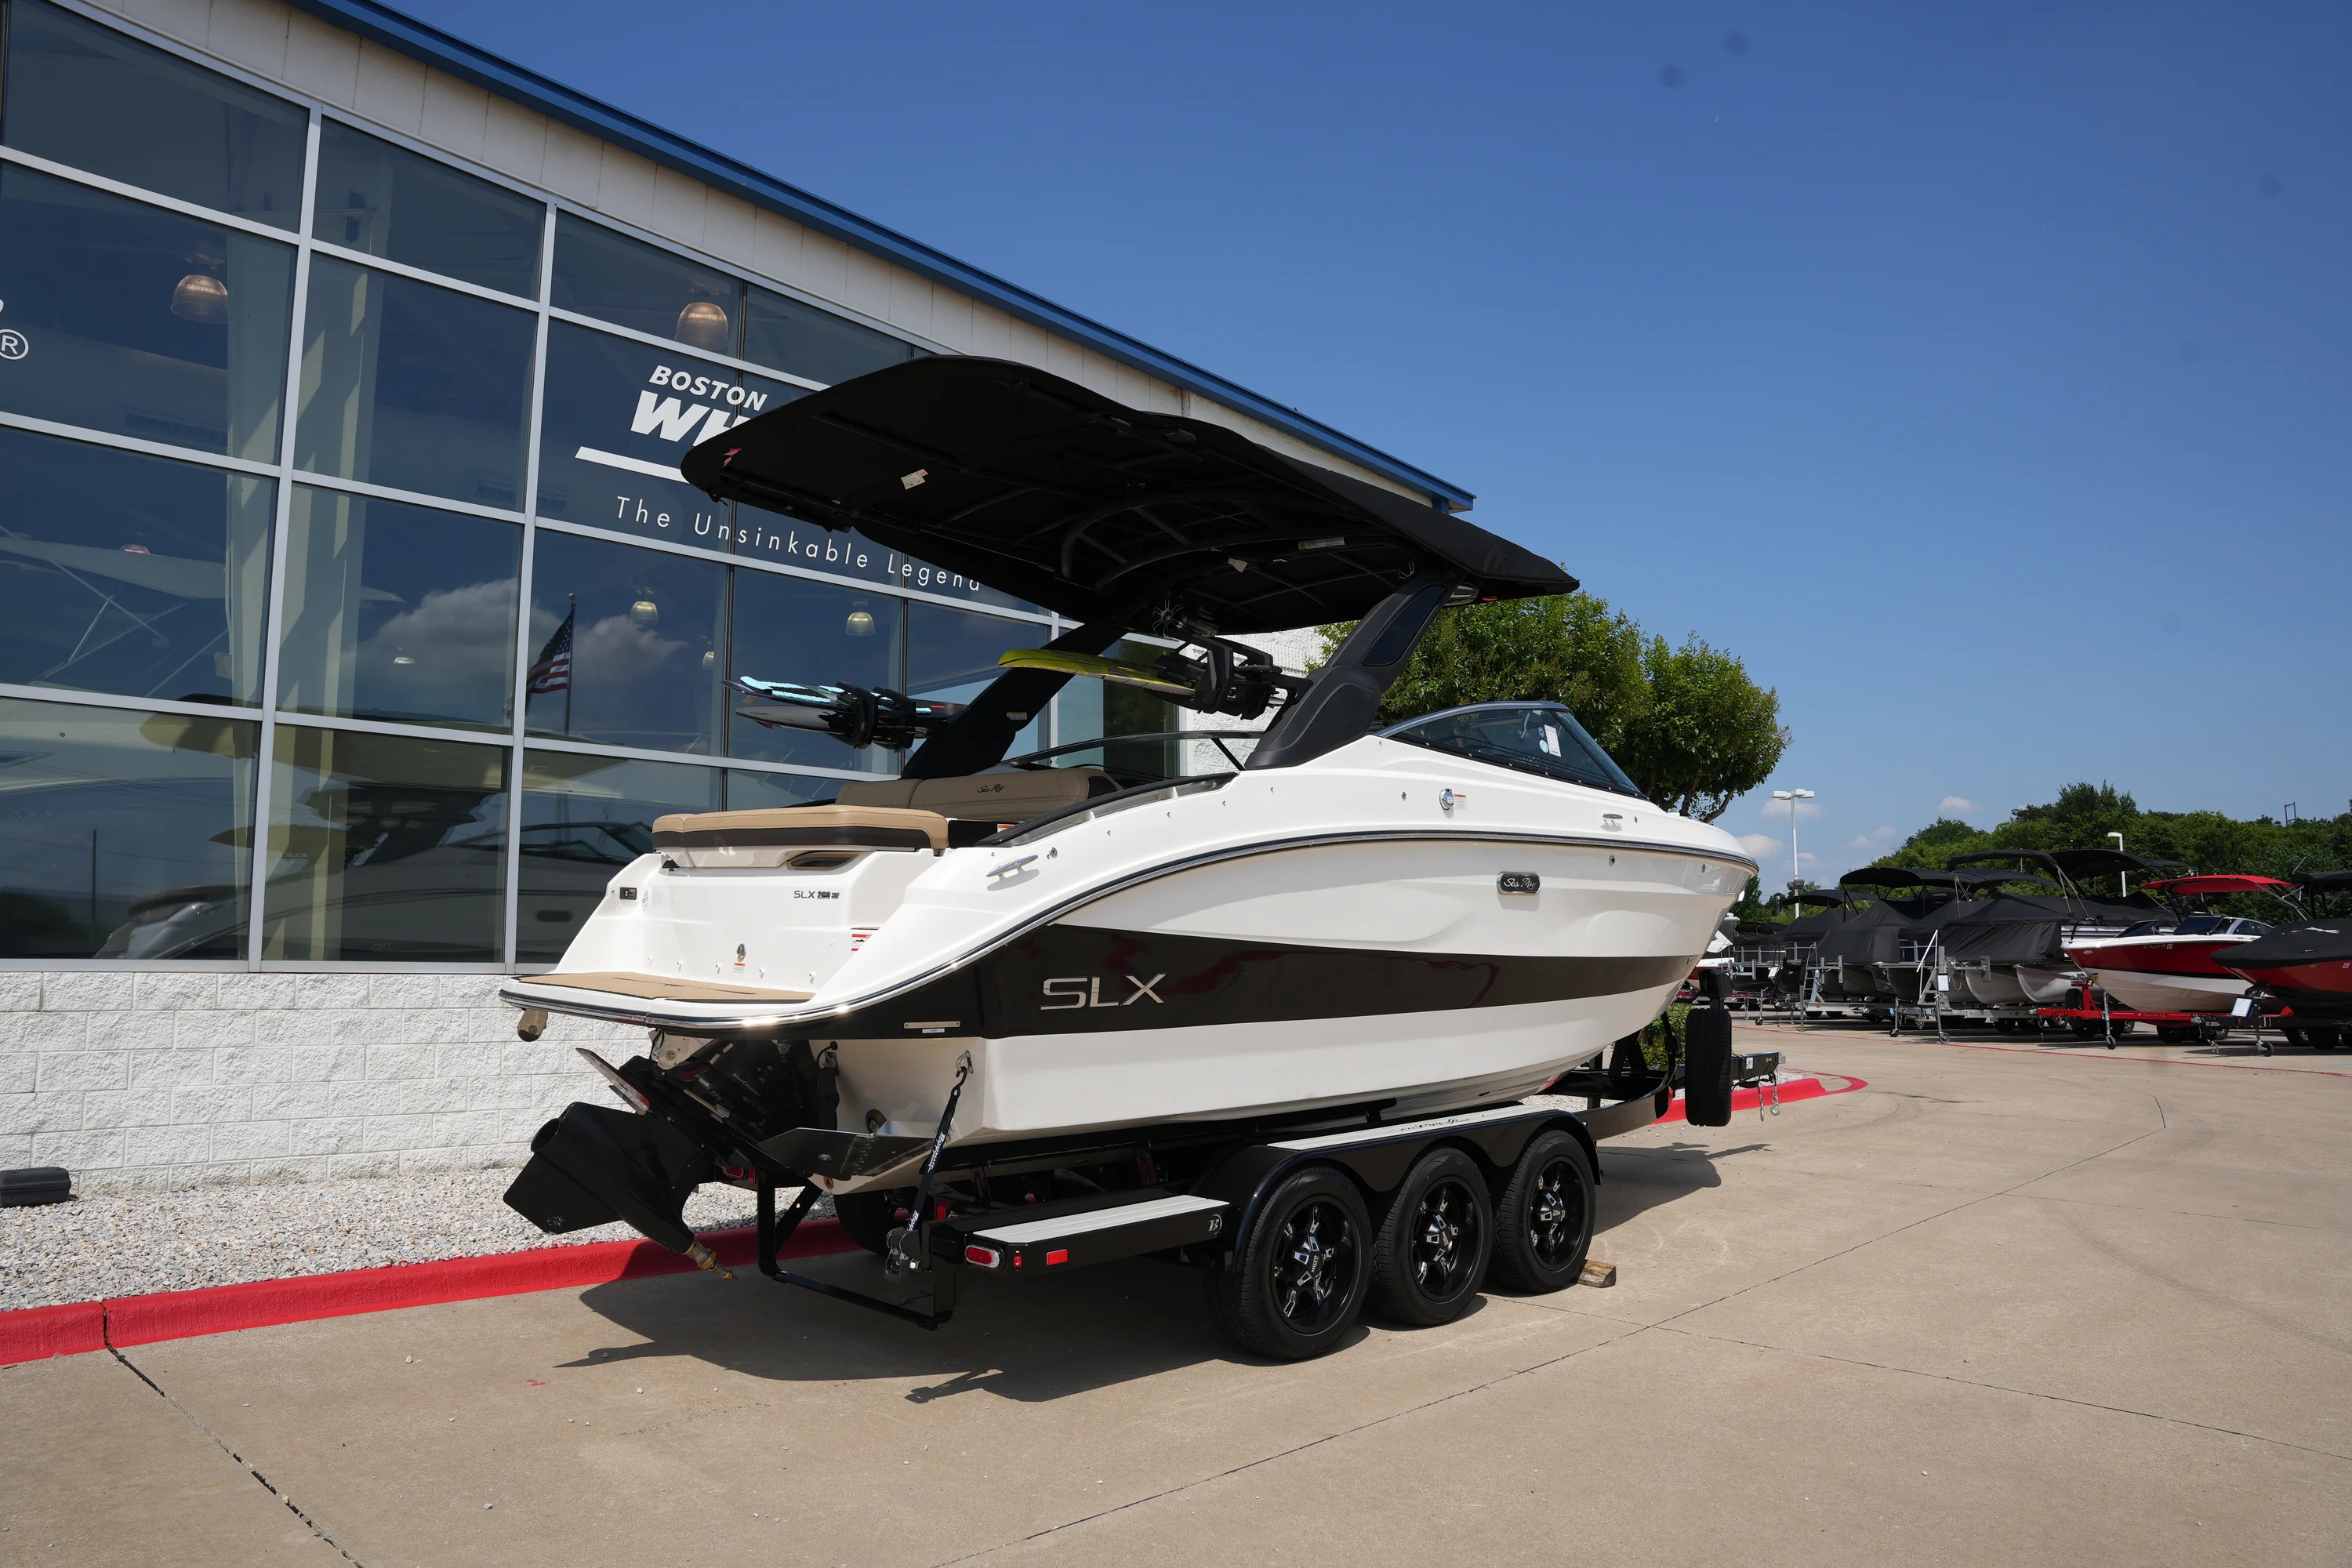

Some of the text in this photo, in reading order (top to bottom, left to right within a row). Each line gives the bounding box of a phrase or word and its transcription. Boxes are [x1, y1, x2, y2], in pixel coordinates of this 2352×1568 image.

[648, 365, 768, 412] BOSTON
[616, 496, 670, 528] The
[695, 513, 868, 568] Unsinkable
[793, 890, 815, 898] SLX
[1504, 878, 1537, 890] Sea Ray
[1040, 972, 1167, 1010] SLX
